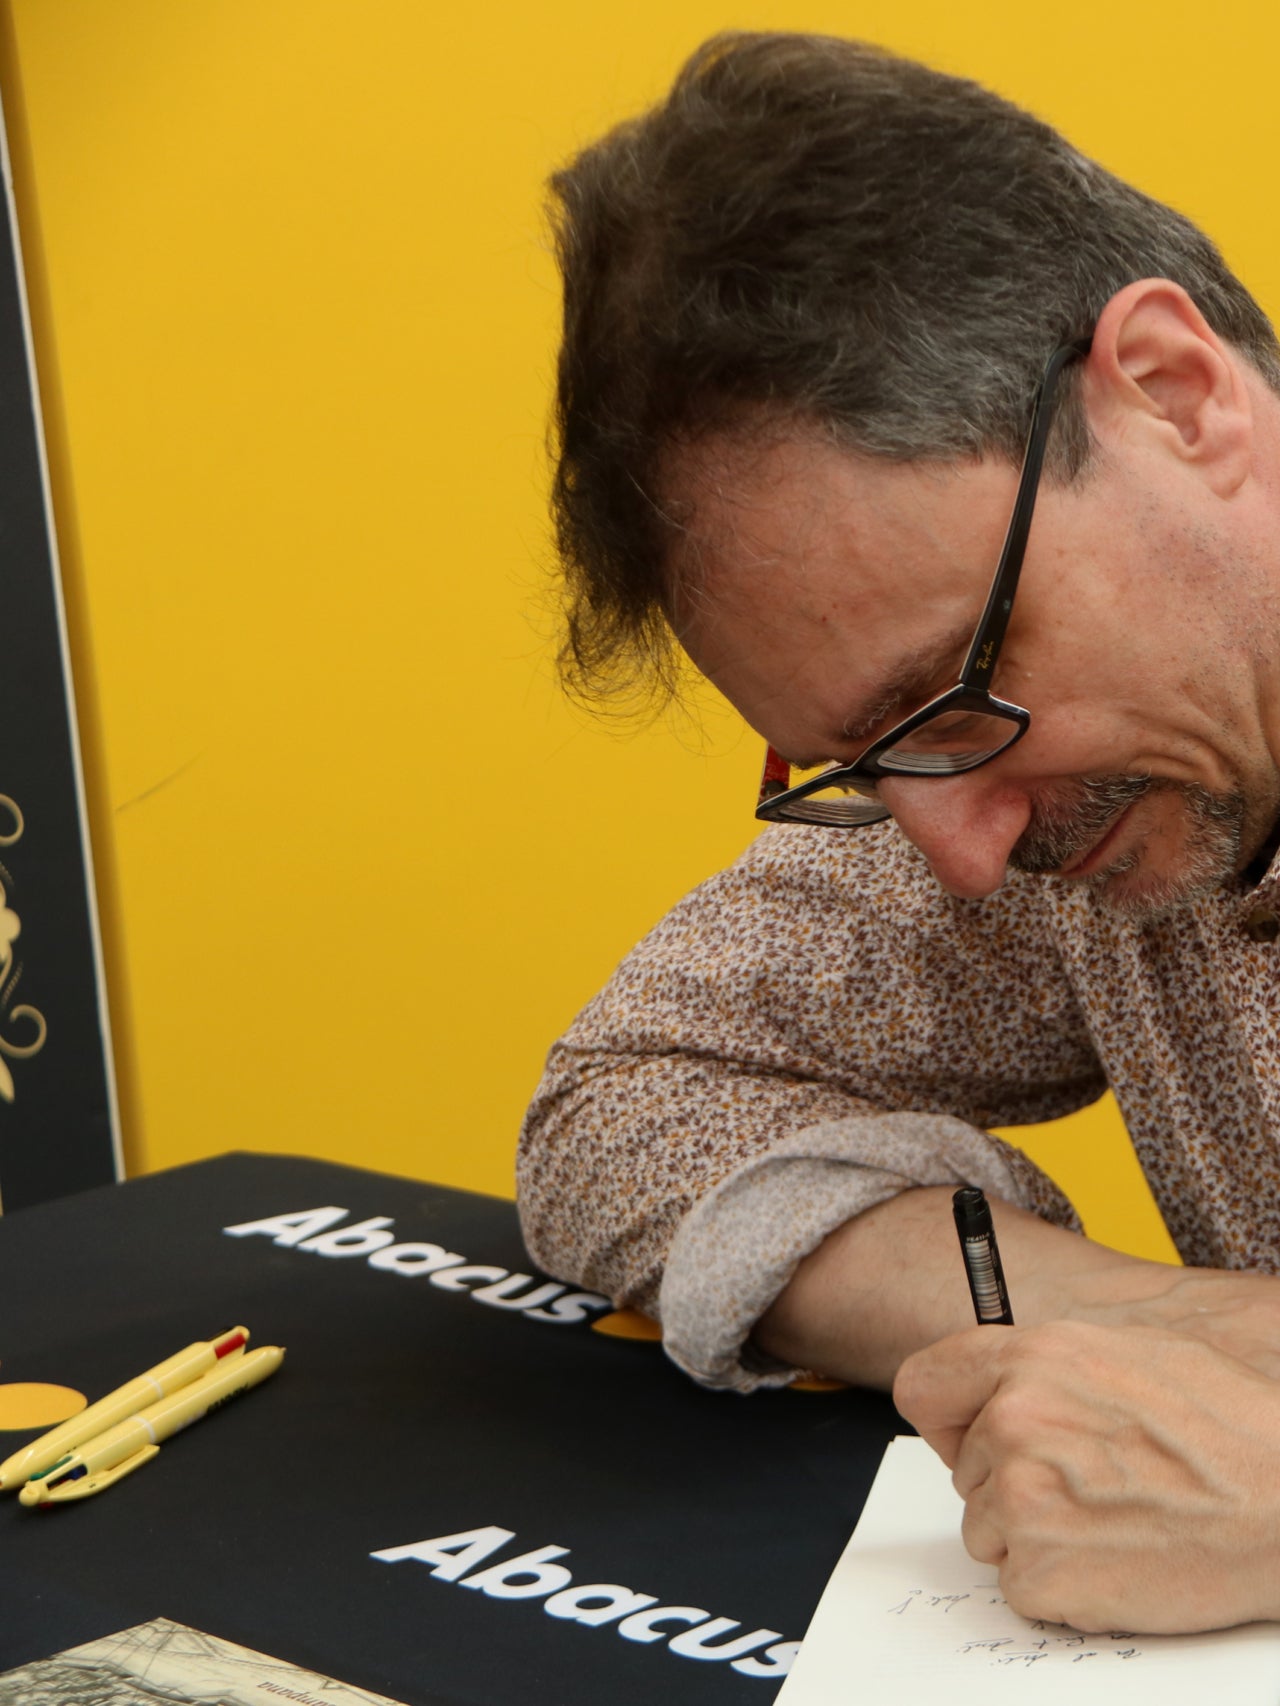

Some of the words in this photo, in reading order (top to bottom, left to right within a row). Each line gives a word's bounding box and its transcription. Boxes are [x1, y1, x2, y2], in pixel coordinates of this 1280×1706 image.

[221, 1206, 612, 1324] Abacus
[366, 1525, 803, 1677] Abacus
[257, 1682, 329, 1706] ampana
